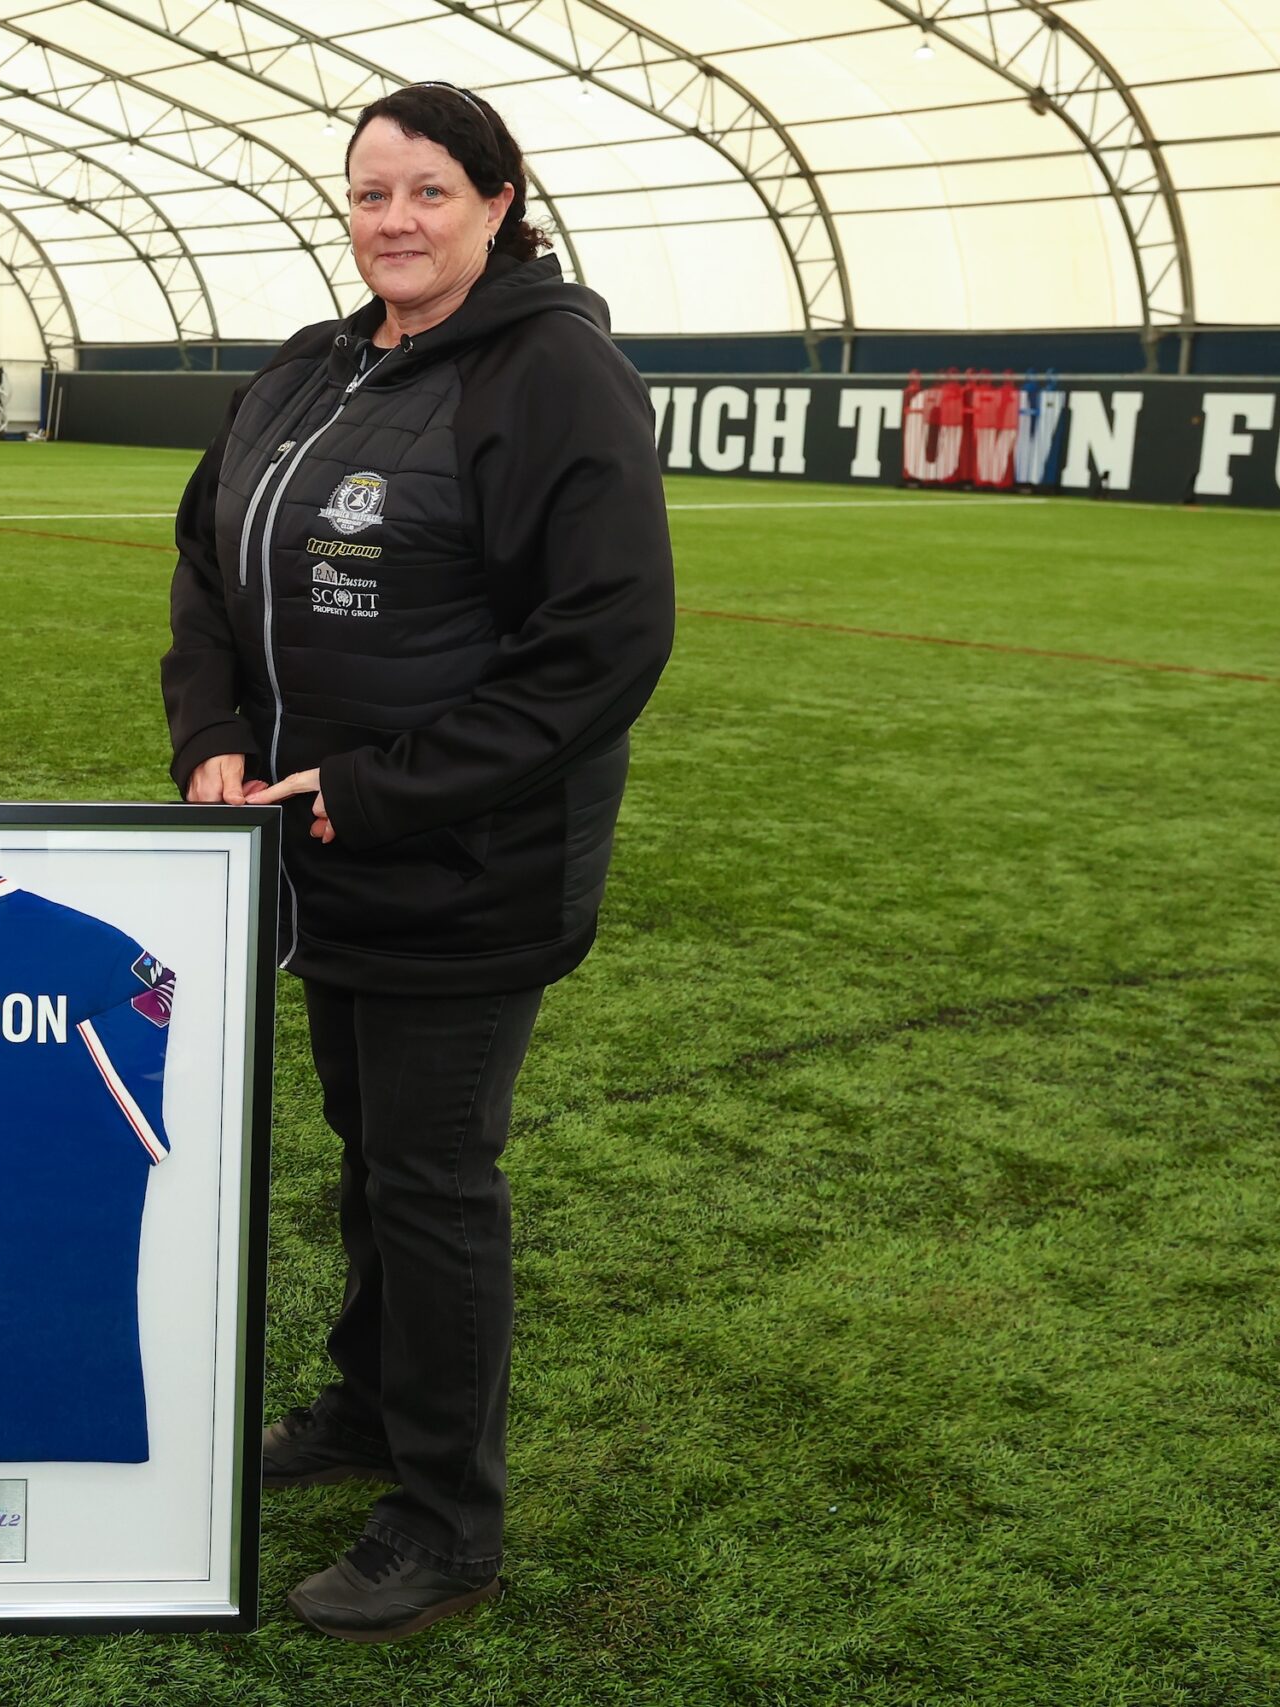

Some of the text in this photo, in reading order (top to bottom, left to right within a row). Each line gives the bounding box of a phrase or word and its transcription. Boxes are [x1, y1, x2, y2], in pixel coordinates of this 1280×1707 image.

[838, 388, 1144, 491] TOWN
[1195, 393, 1280, 496] F
[306, 537, 382, 559] tru7group
[338, 572, 377, 588] Euston
[312, 604, 379, 618] PROPERTY GROUP
